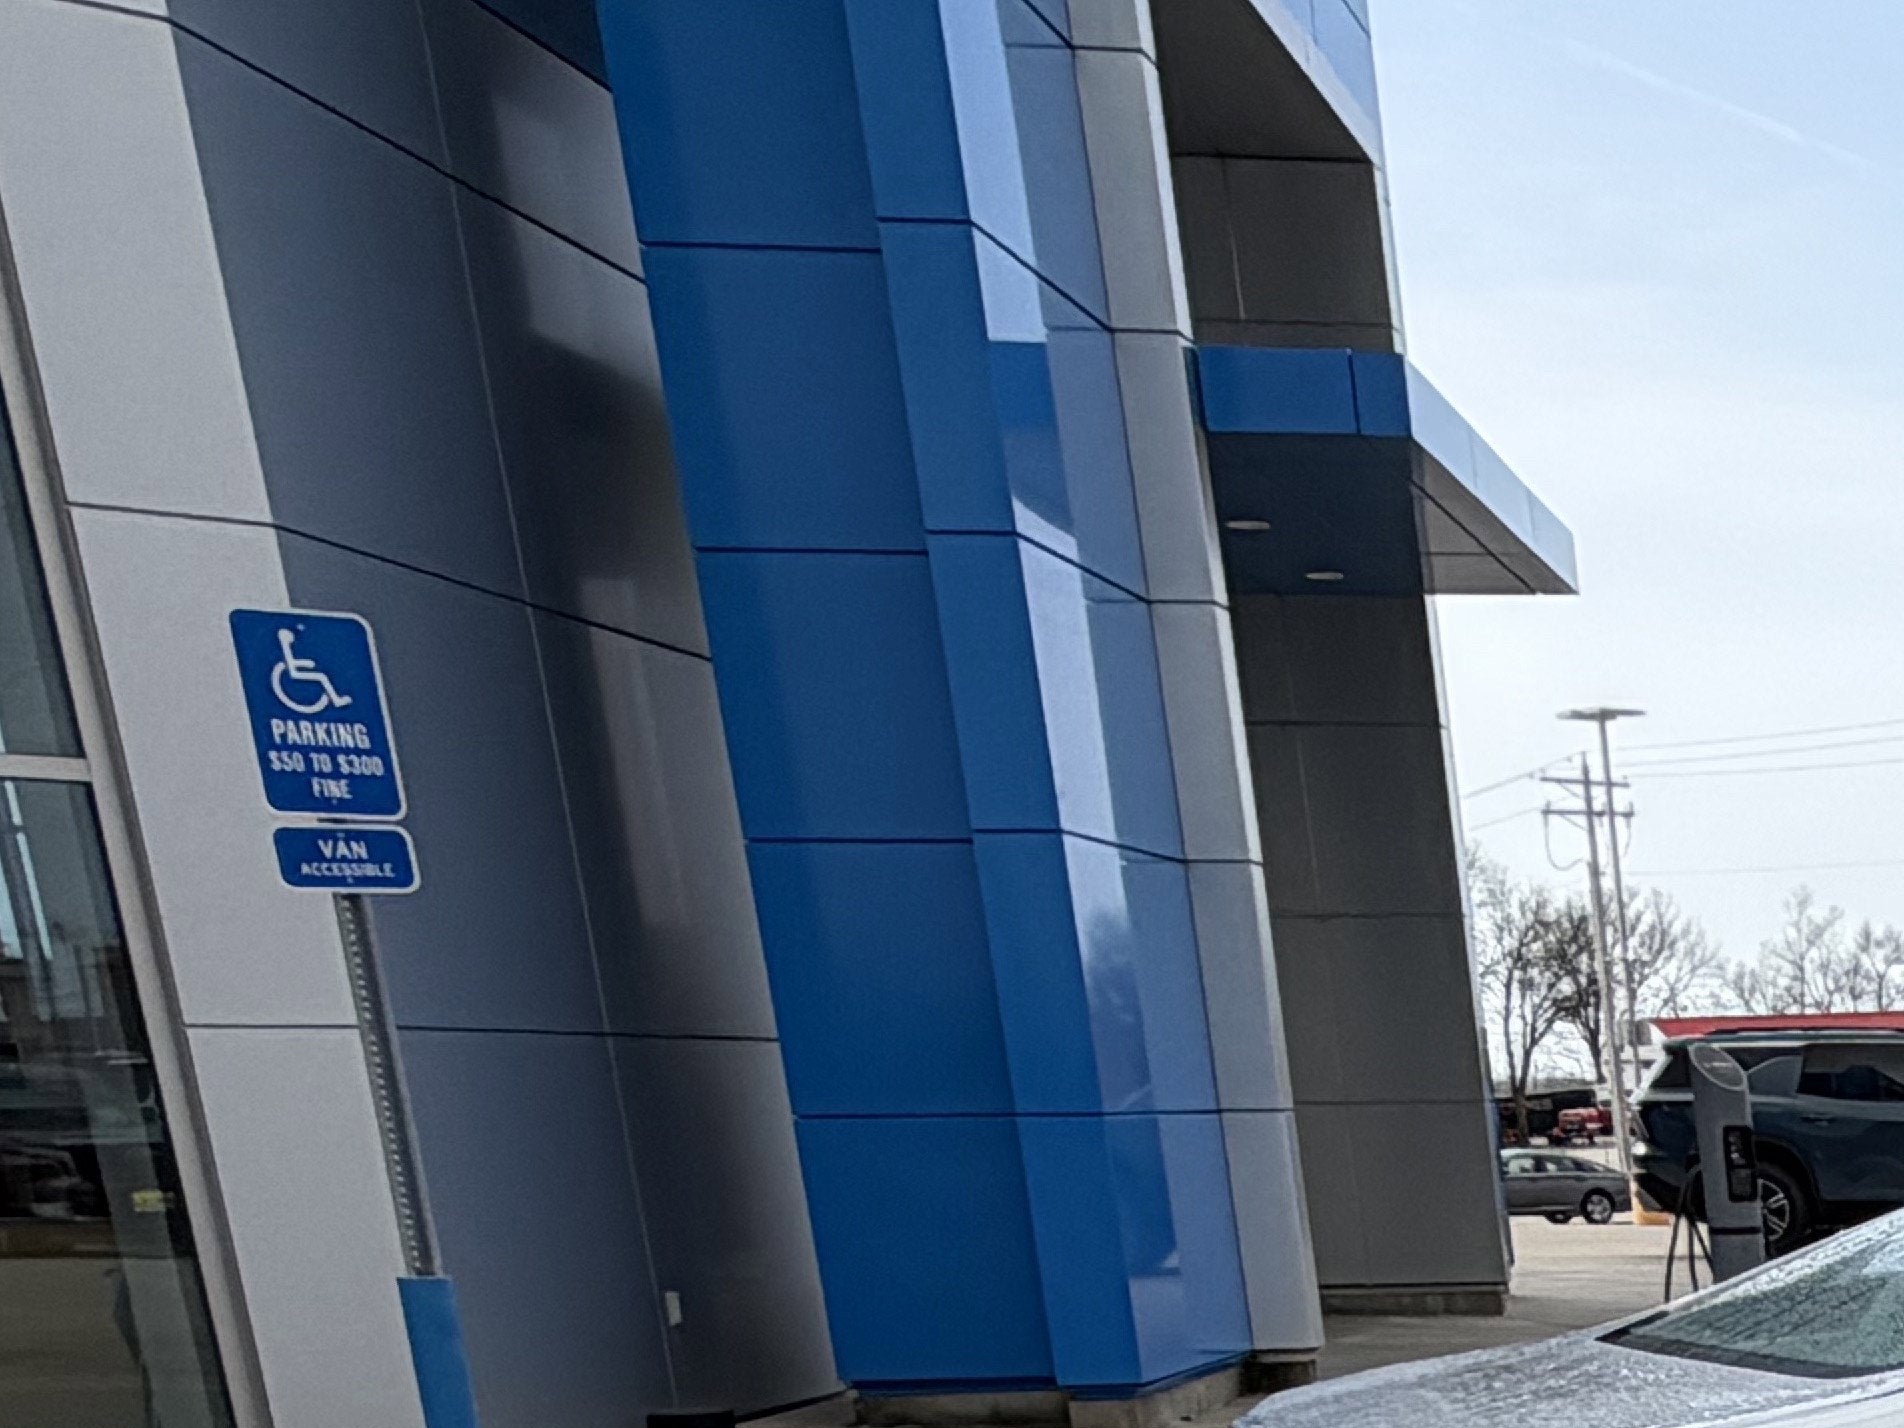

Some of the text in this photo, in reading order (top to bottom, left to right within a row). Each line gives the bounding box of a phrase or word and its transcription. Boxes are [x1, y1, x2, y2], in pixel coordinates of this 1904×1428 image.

[270, 718, 372, 750] PARKING
[267, 750, 385, 777] $50 TO $300
[311, 776, 353, 800] FINE
[317, 838, 370, 860] VAN
[300, 862, 397, 878] ACCESSIBLE
